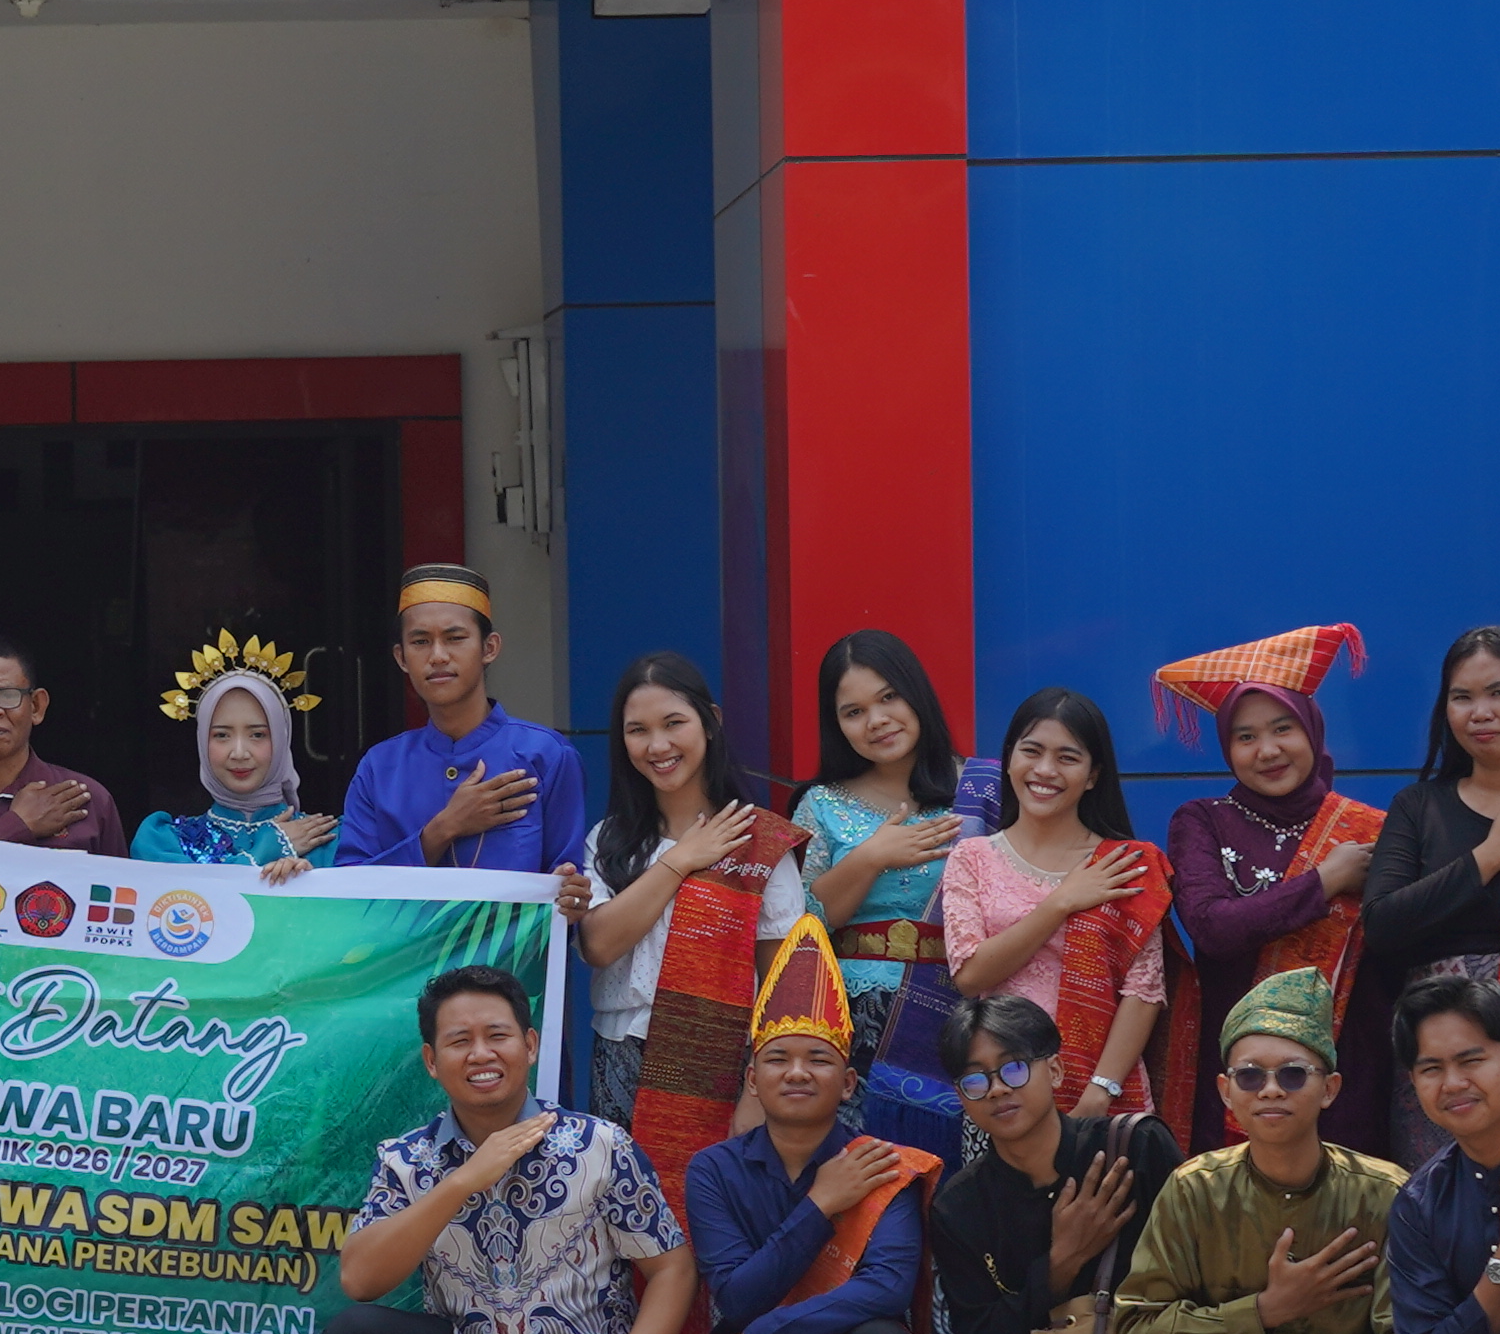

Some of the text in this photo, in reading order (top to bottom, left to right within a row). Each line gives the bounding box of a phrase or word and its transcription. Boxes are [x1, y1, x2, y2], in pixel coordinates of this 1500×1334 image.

[86, 925, 133, 937] sawit
[96, 1094, 251, 1151] BARU
[36, 1142, 108, 1170] 2026
[133, 1154, 207, 1184] 2027
[97, 1193, 216, 1244] SDM
[232, 1207, 359, 1251] SAW
[75, 1241, 318, 1290] PERKEBUNAN)
